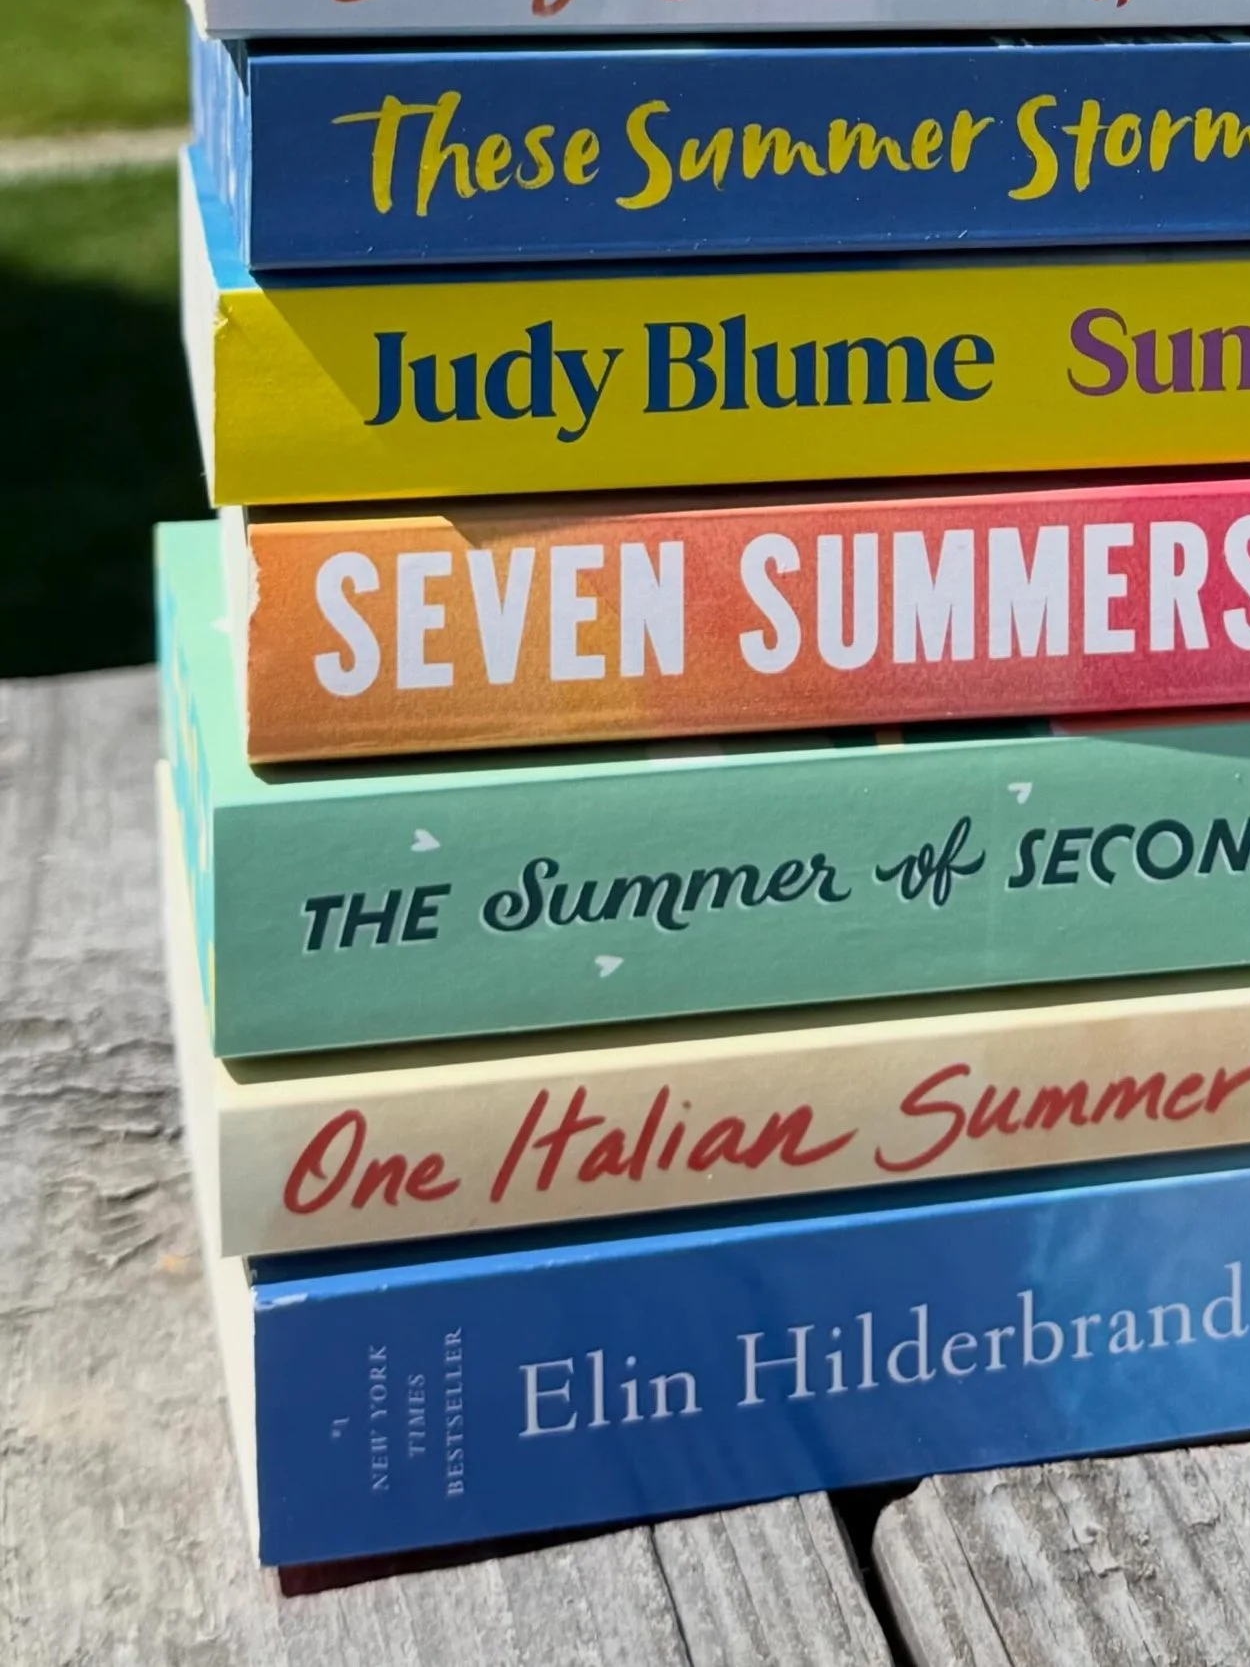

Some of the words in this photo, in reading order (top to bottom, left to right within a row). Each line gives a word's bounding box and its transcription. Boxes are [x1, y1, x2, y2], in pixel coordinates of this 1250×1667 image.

[331, 90, 601, 216] These
[615, 99, 995, 210] Summer
[364, 319, 625, 444] Judy
[643, 313, 995, 414] Blume
[313, 540, 685, 698] SEVEN
[302, 882, 453, 952] THE
[480, 852, 852, 933] Summer
[874, 815, 986, 907] of
[283, 1108, 461, 1215] One
[489, 1085, 858, 1203] Italian
[369, 1344, 388, 1420] YORK
[444, 1326, 465, 1496] BESTSELLER
[518, 1349, 702, 1437] Elin
[736, 1261, 1250, 1408] Hilderbrand
[370, 1429, 389, 1491] NEW
[407, 1373, 426, 1458] TIMES
